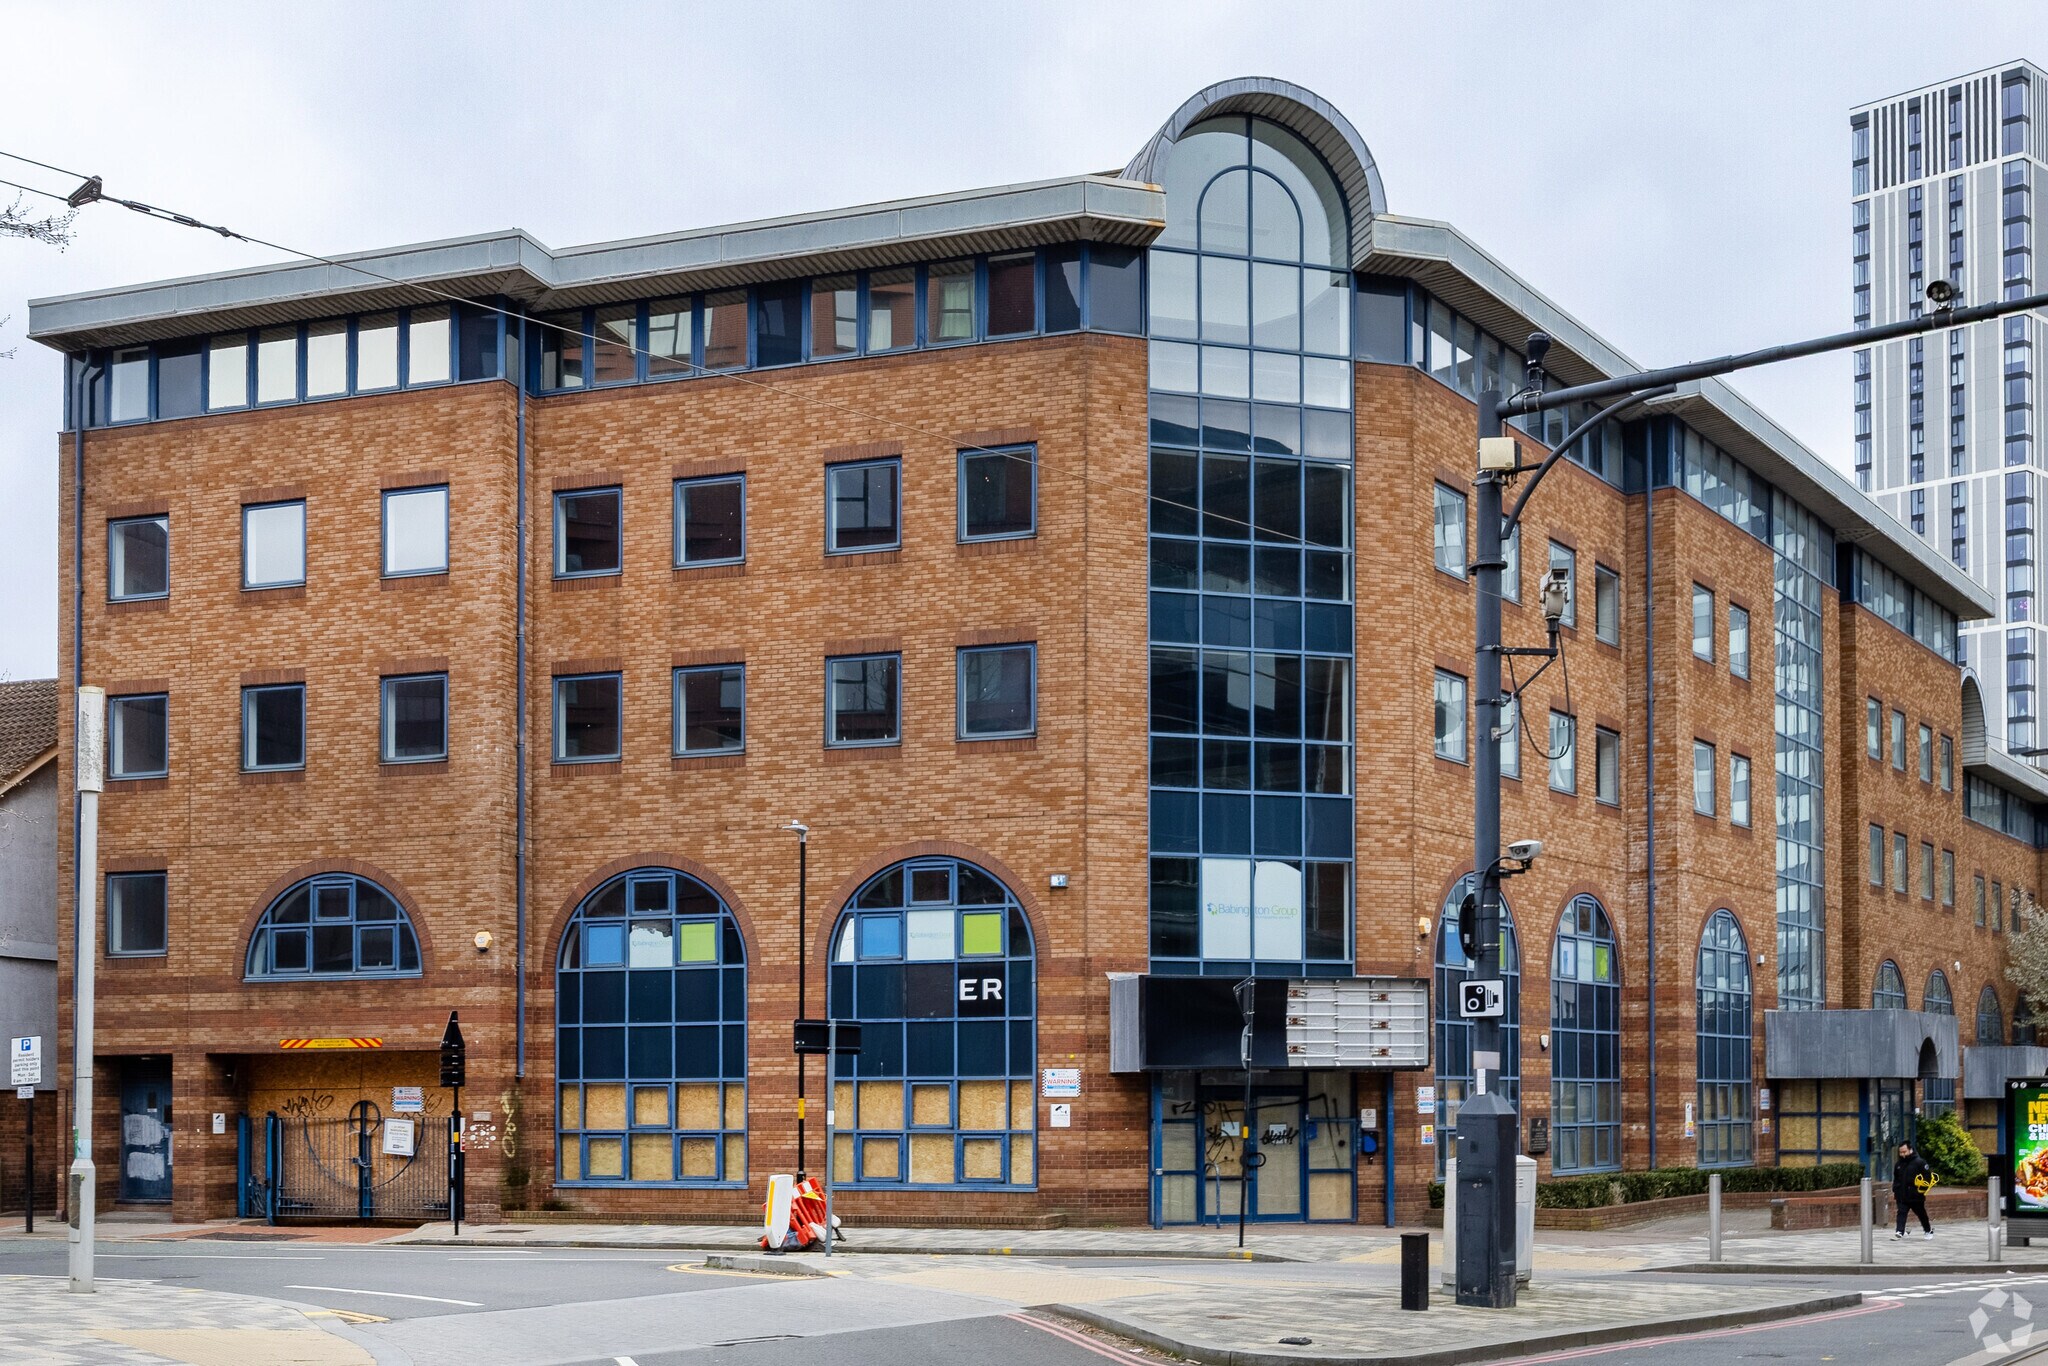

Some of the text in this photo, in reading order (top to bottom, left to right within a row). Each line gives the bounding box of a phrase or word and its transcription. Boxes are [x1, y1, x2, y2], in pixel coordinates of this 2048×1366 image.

[1219, 903, 1298, 917] Babington Group
[959, 978, 1003, 1001] ER
[23, 1040, 30, 1050] P
